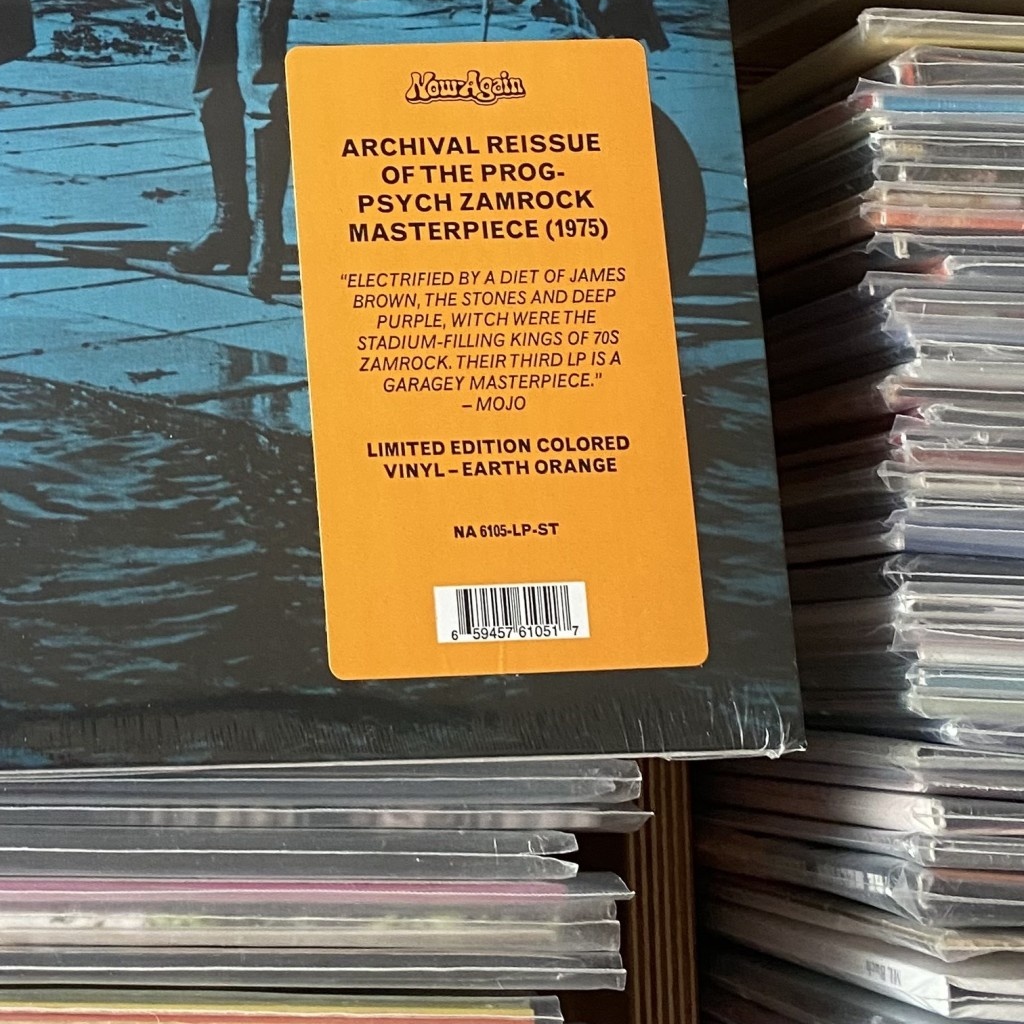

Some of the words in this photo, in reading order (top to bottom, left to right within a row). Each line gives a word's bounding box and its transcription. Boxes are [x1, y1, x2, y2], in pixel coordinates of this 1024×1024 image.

[342, 137, 479, 157] ARCHIVAL
[487, 134, 600, 153] REISSUE
[382, 166, 414, 184] OF
[424, 165, 473, 183] THE
[481, 163, 564, 181] PROG-
[359, 193, 451, 213] PSYCH
[460, 190, 593, 210] ZAMROCK
[350, 220, 539, 242] MASTERPIECE
[546, 218, 608, 241] (1975)
[341, 272, 454, 287] “ELECTRIFIED
[459, 271, 480, 285] BY
[484, 271, 494, 284] A
[501, 270, 539, 283] DIET
[545, 269, 565, 283] OF
[570, 268, 625, 282] JAMES
[353, 293, 420, 309] BROWN,
[425, 293, 457, 306] THE
[462, 291, 526, 306] STONES
[531, 290, 567, 304] AND
[573, 289, 616, 303] DEEP
[377, 314, 445, 329] PURPLE,
[452, 312, 509, 327] WITCH
[514, 311, 560, 325] WERE
[564, 310, 595, 324] THE
[358, 333, 504, 350] STADIUM-FILLING
[511, 332, 562, 346] KINGS
[568, 331, 588, 345] OF
[594, 330, 619, 344] 70S
[360, 356, 451, 371] ZAMROCK.
[457, 354, 506, 369] THEIR
[511, 353, 562, 367] THIRD
[568, 352, 586, 366] LP
[592, 352, 605, 365] IS
[610, 351, 621, 365] A
[384, 377, 464, 392] GARAGEY
[368, 441, 445, 457] LIMITED
[451, 439, 530, 454] EDITION
[537, 436, 629, 452] COLORED
[535, 458, 617, 474] ORANGE
[454, 526, 476, 538] NA
[480, 523, 559, 537] 6105-LP-ST
[451, 630, 459, 641] 6
[472, 627, 514, 640] 59457
[518, 625, 558, 638] 61051
[572, 625, 579, 636] 7
